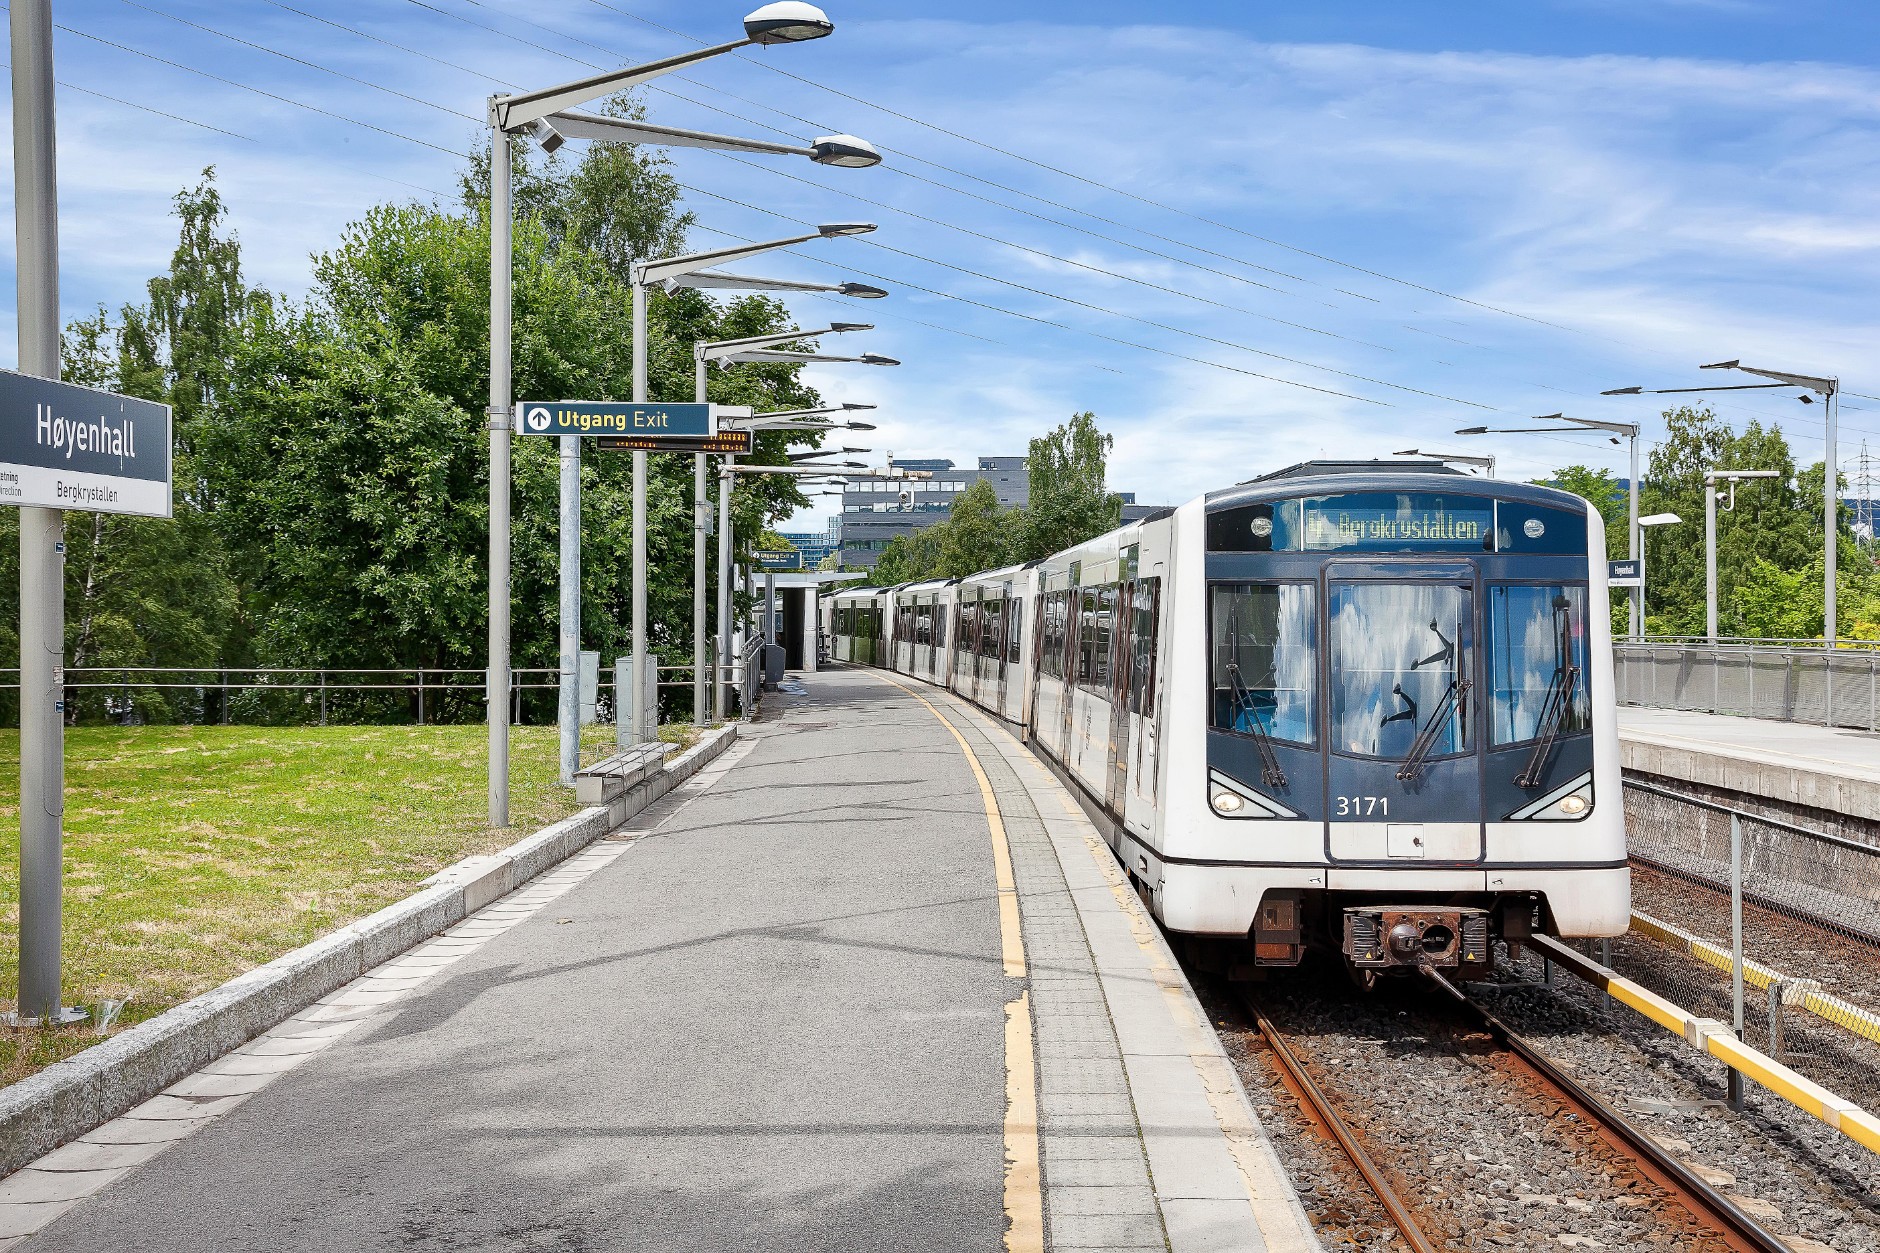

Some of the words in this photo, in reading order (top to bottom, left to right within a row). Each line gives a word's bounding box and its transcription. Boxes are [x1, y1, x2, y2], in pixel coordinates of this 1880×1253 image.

[37, 403, 136, 459] Høyenhall
[558, 410, 627, 431] Utgang
[634, 411, 668, 428] Exit
[57, 480, 118, 503] Bergkrystallen
[1308, 511, 1324, 539] 4
[1339, 514, 1478, 540] Bergkrystallen
[1336, 796, 1389, 816] 3171
